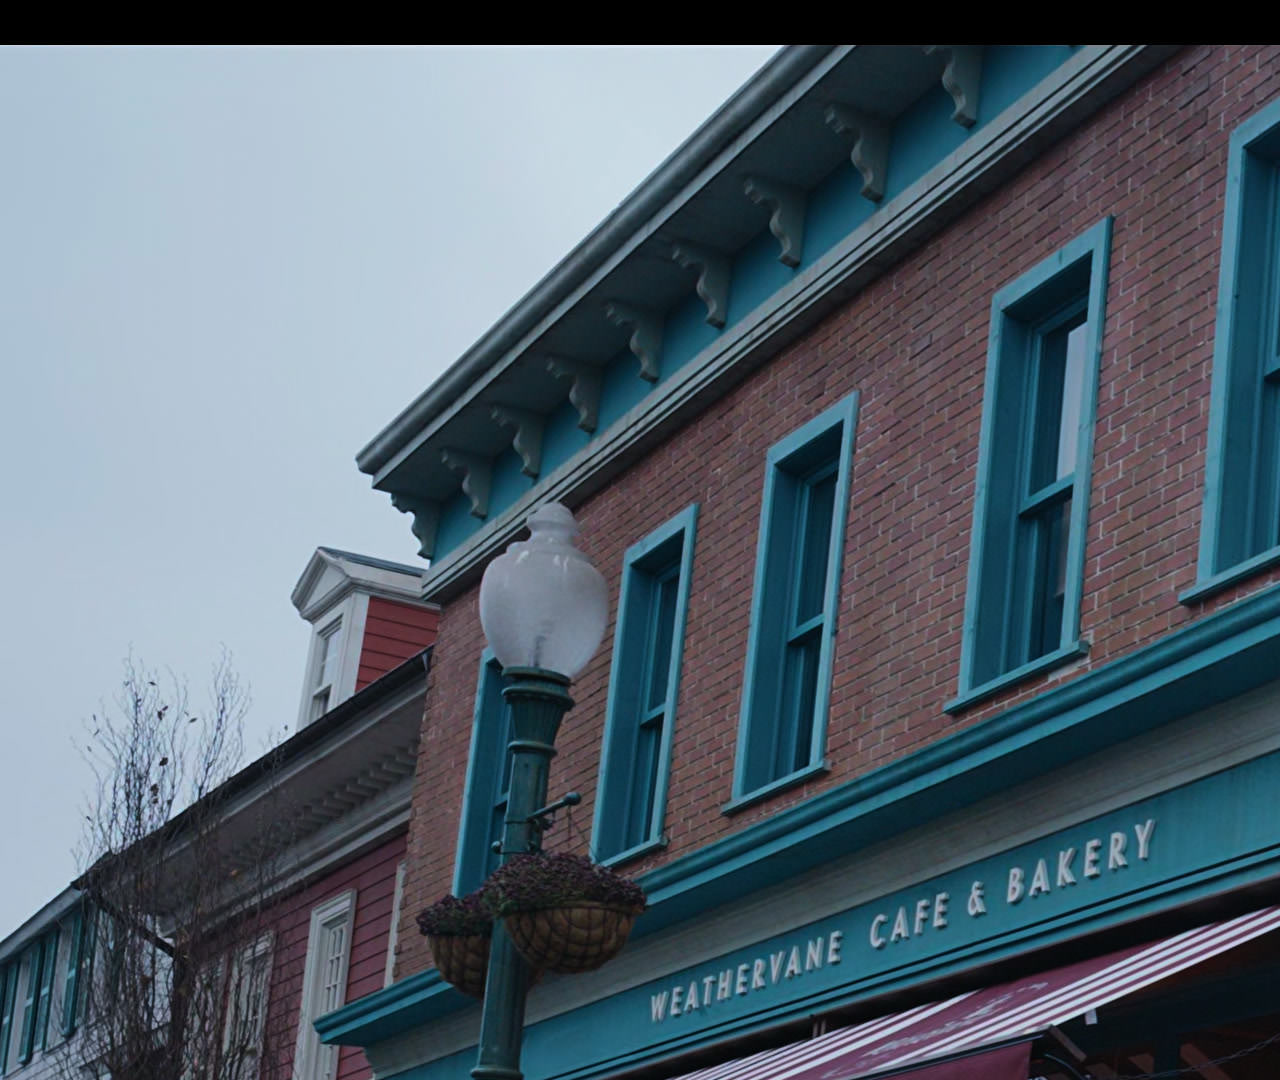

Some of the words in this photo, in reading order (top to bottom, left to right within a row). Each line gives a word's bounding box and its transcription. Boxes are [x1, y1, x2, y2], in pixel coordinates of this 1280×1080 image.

[650, 930, 845, 1024] WEATHERVANE
[869, 890, 950, 950] CAFE
[966, 879, 989, 918] &
[1005, 818, 1157, 904] BAKERY
